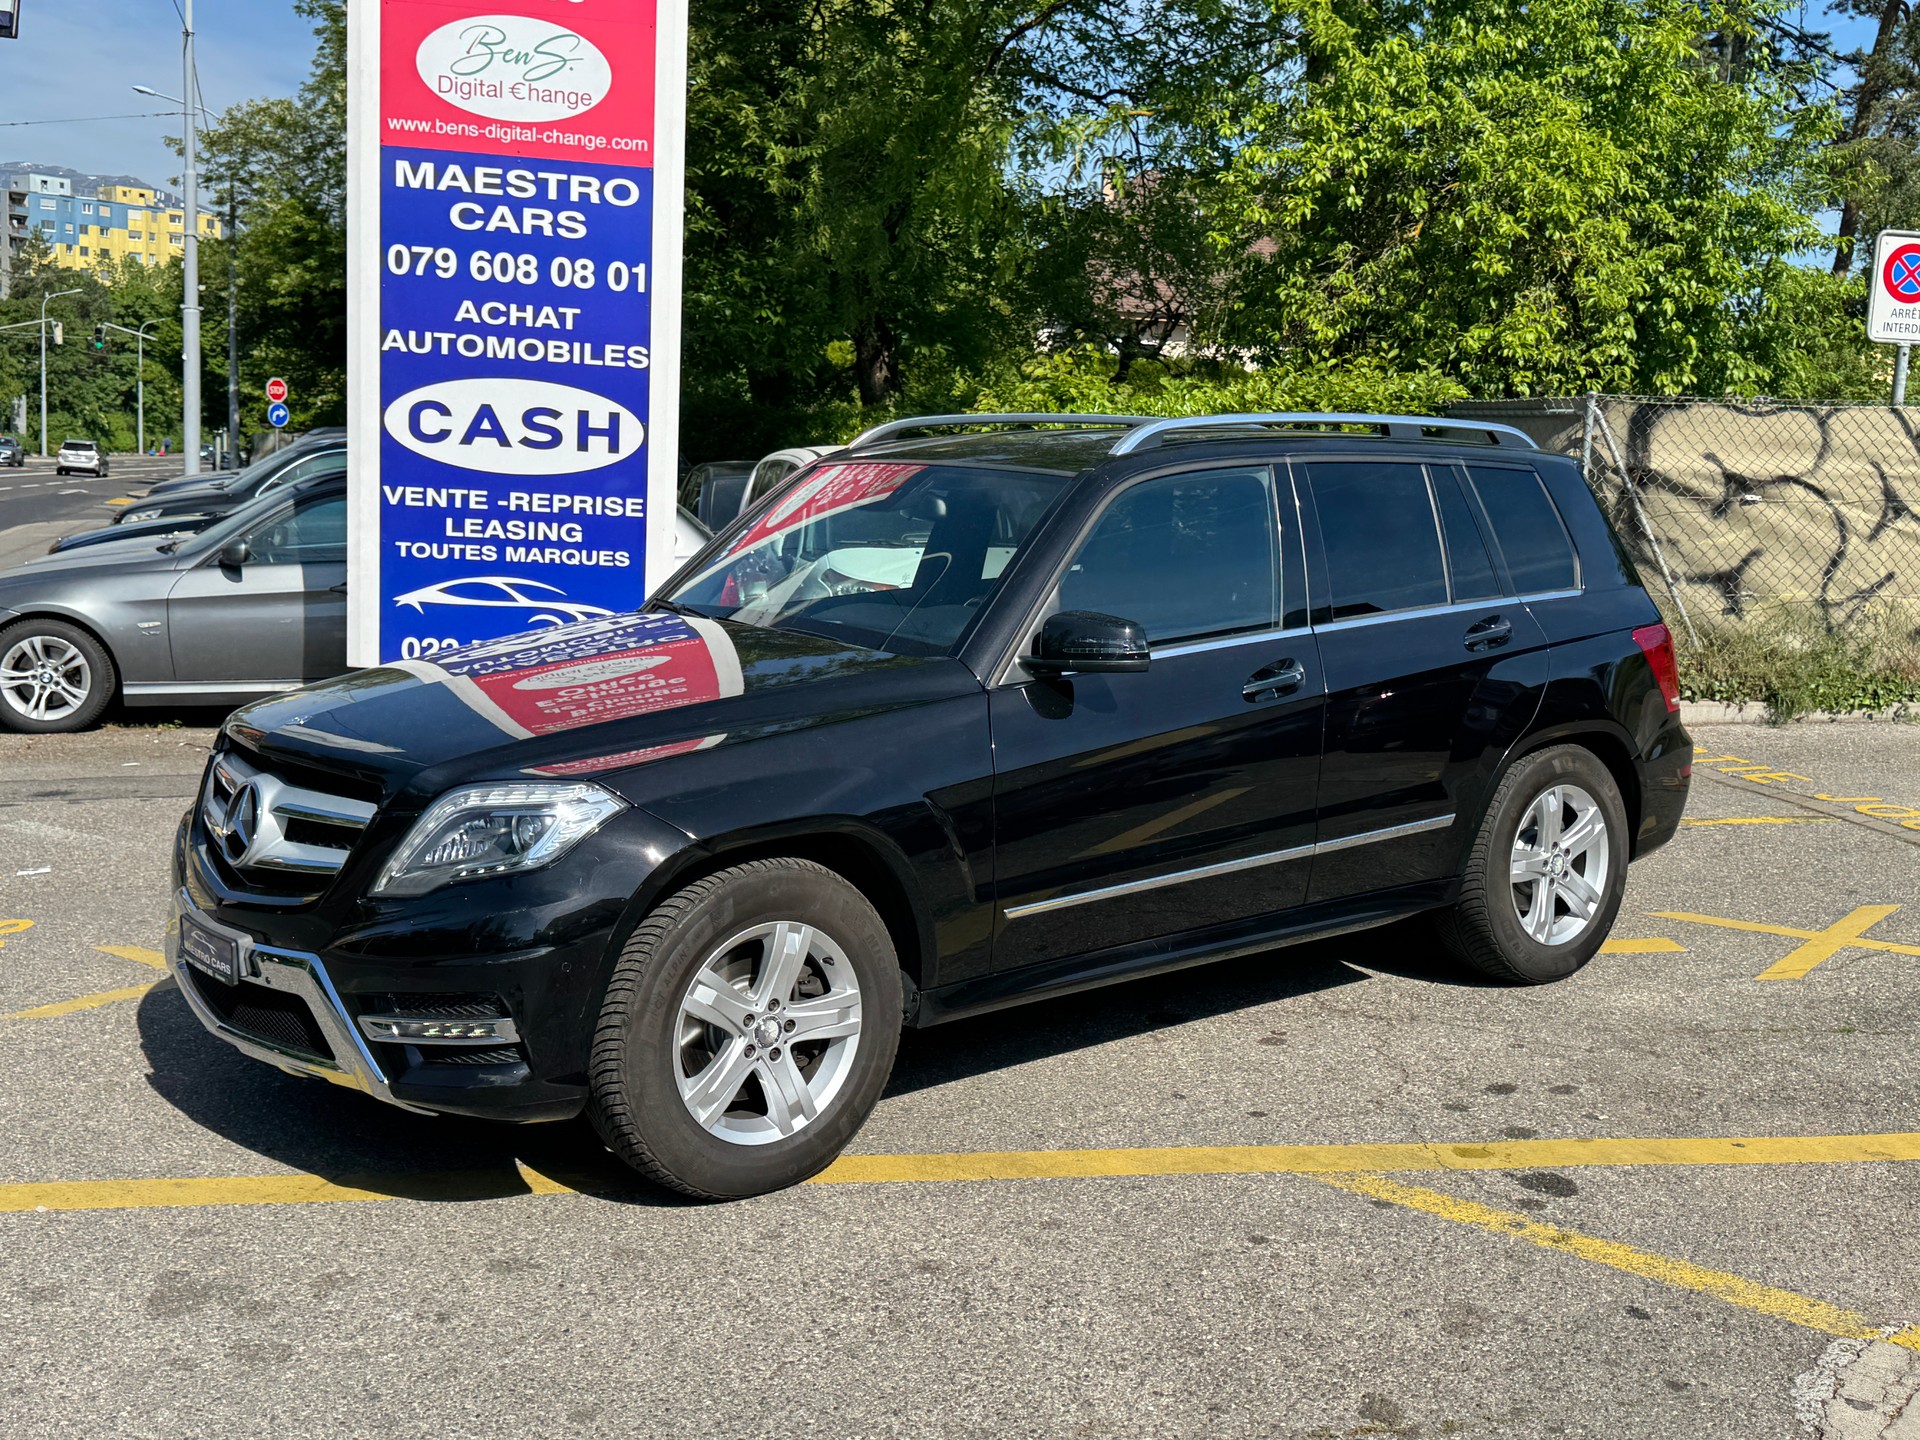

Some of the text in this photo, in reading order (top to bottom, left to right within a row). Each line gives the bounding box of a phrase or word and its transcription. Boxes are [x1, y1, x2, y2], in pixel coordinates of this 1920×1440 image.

[437, 74, 503, 100] Digital
[387, 117, 649, 152] www.bens-digital-change.com
[394, 159, 640, 207] MAESTRO
[449, 202, 587, 240] CARS
[387, 244, 647, 293] 079 608 08 01
[454, 300, 581, 330] ACHAT
[381, 329, 650, 369] AUTOMOBILES
[269, 385, 285, 395] STOP
[408, 399, 621, 455] CASH
[382, 485, 488, 511] VENTE
[445, 517, 583, 543] LEASING
[395, 541, 631, 568] TOUTES MARQUES
[211, 957, 231, 974] CARS
